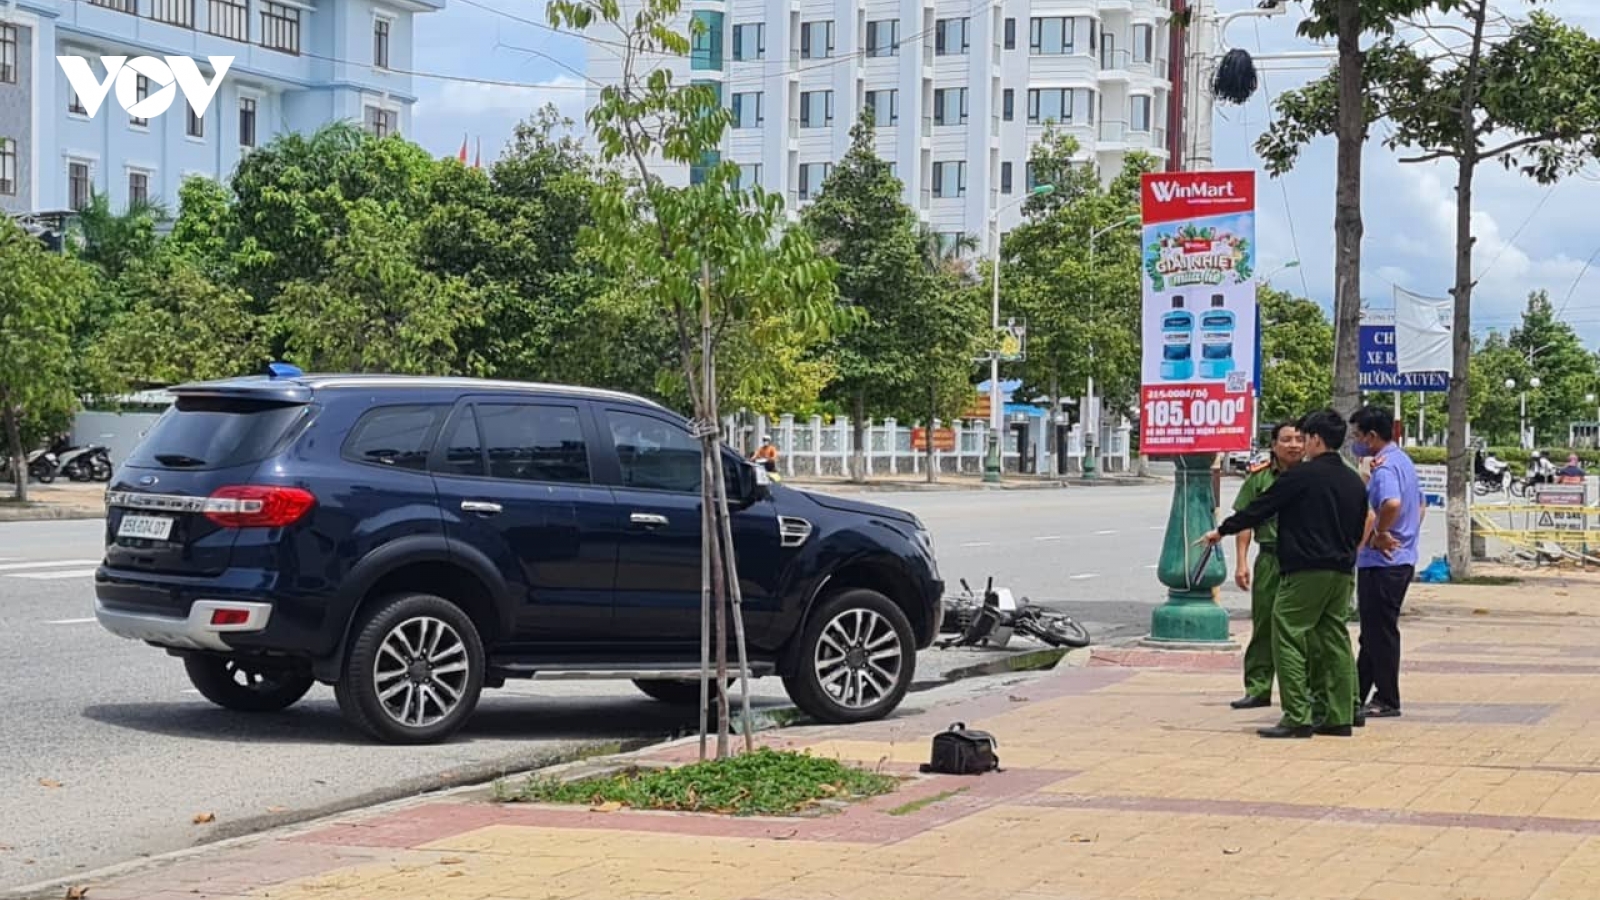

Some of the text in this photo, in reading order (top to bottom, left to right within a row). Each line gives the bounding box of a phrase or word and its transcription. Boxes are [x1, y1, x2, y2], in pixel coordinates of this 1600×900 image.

[1150, 180, 1234, 202] WinMart
[1374, 331, 1395, 345] CH
[1366, 351, 1384, 364] XE
[1359, 368, 1401, 386] HƯỜNG
